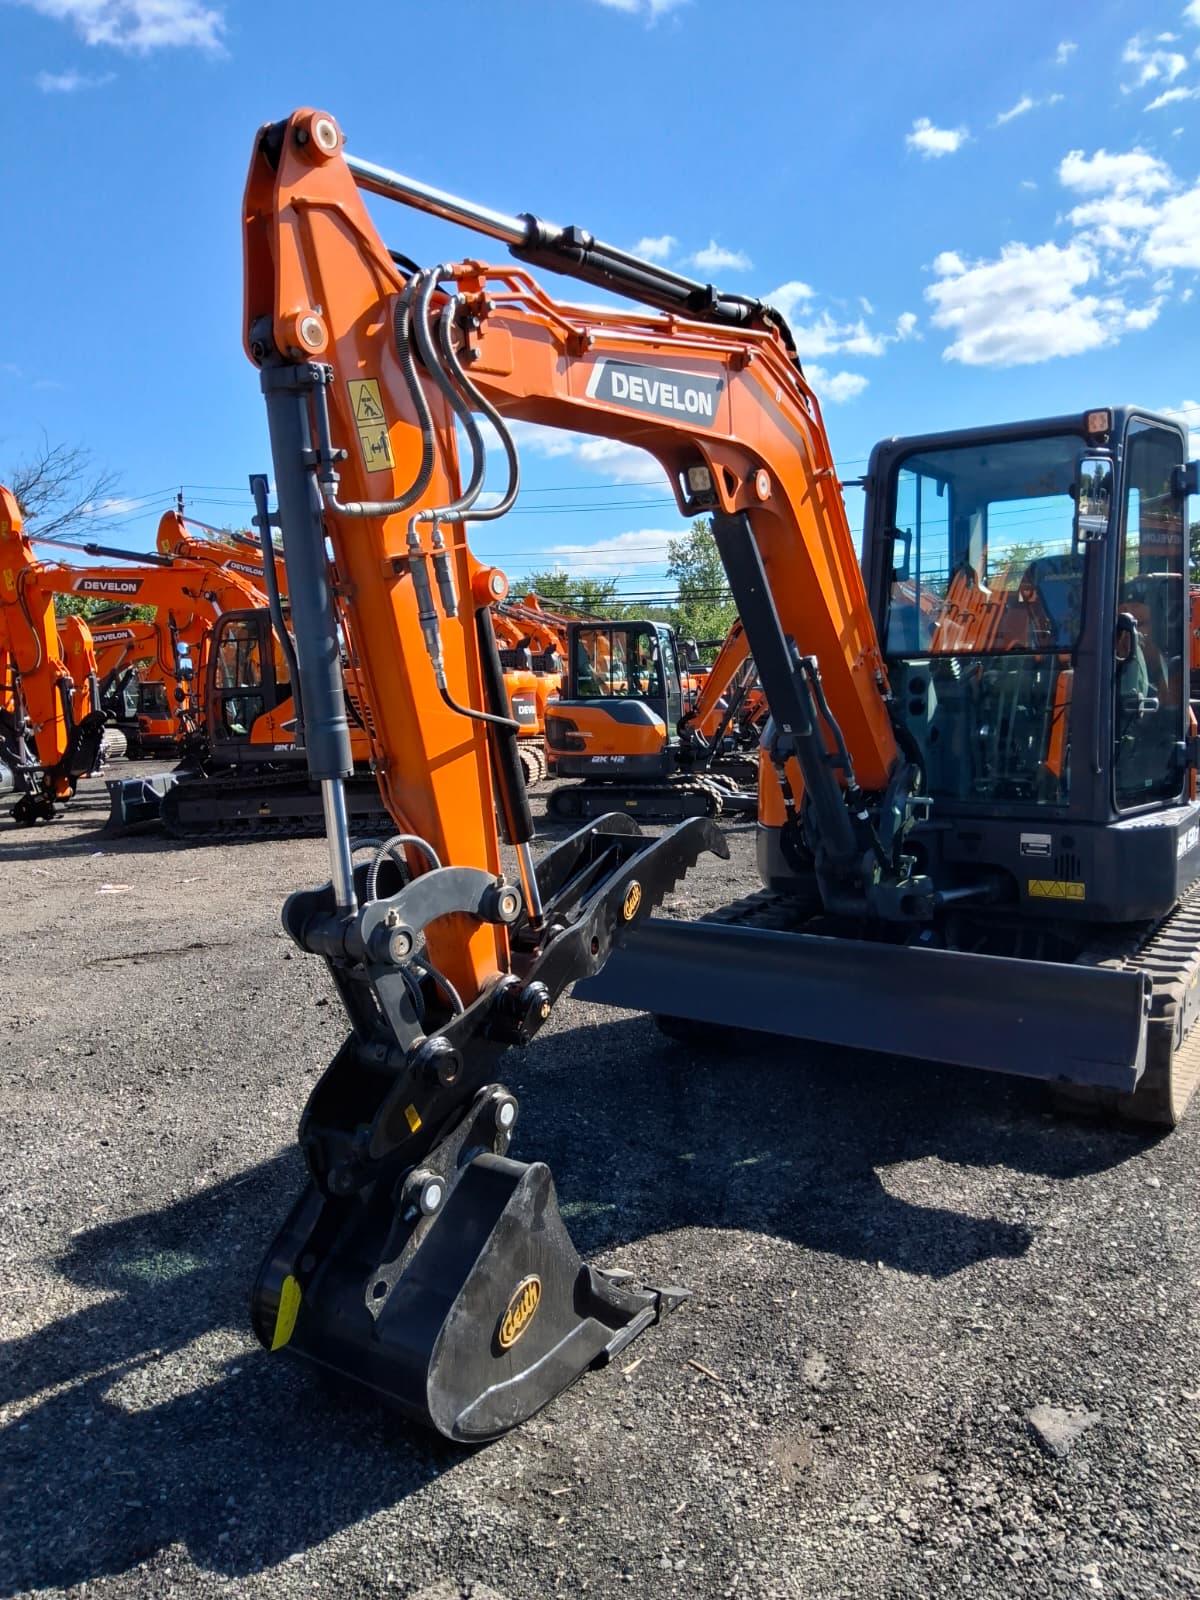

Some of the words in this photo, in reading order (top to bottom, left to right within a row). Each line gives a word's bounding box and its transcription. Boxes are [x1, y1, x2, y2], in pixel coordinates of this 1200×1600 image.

[611, 371, 712, 416] DEVELON
[230, 562, 264, 576] DEVELON
[84, 581, 137, 592] DEVELON
[93, 631, 128, 642] DEVELON
[610, 755, 625, 764] 42
